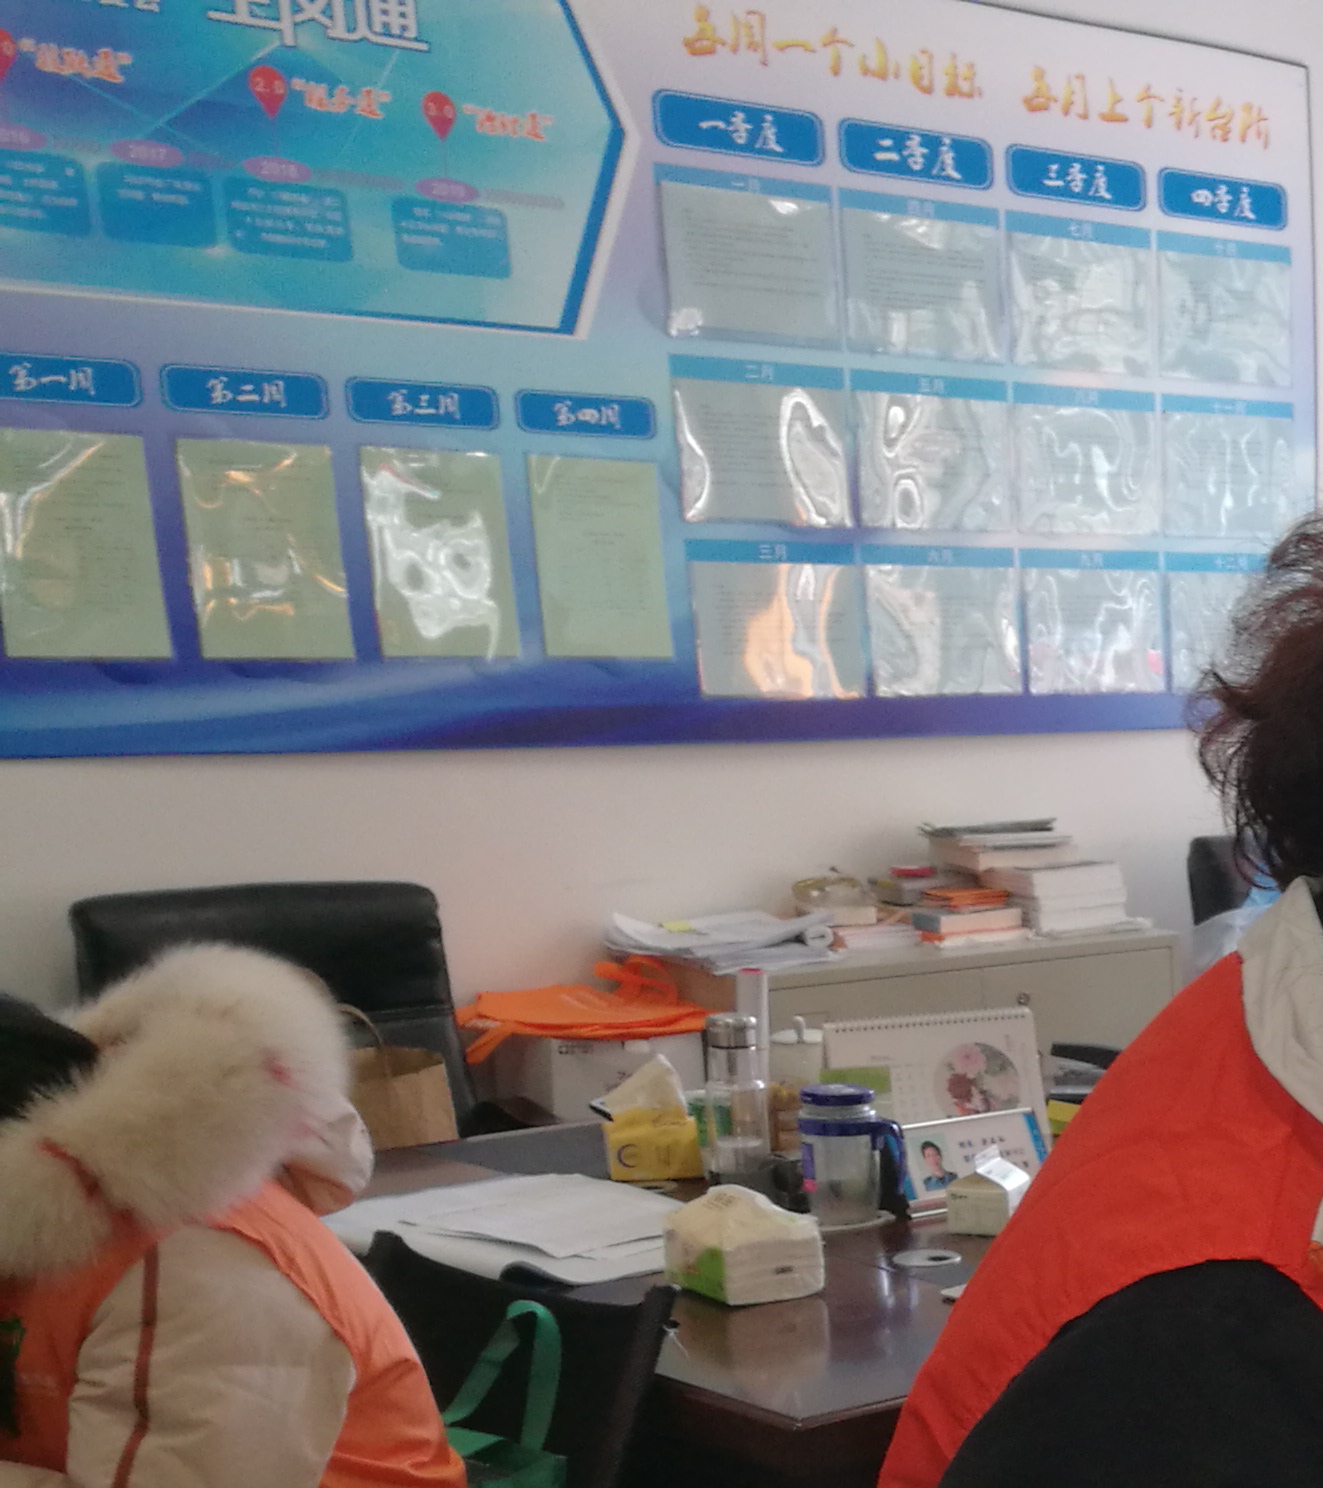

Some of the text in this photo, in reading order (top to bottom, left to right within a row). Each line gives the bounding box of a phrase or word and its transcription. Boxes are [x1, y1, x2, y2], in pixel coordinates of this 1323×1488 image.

[682, 5, 1269, 150] 每周一个小目标 每月上个新台阶
[699, 110, 784, 152] 一季度
[873, 134, 962, 180] 二季度
[731, 178, 760, 195] 一月
[1041, 163, 1112, 200] 三季度
[1190, 184, 1256, 221] 四季度
[1068, 222, 1094, 240] 七月
[9, 362, 96, 396] 第一周
[745, 364, 775, 382] 二月
[919, 377, 945, 394] 五月
[206, 376, 288, 408] 第二周
[387, 388, 461, 420] 第三周
[1213, 398, 1247, 416] 十一月
[553, 400, 621, 430] 第四周
[759, 543, 787, 561] 三月
